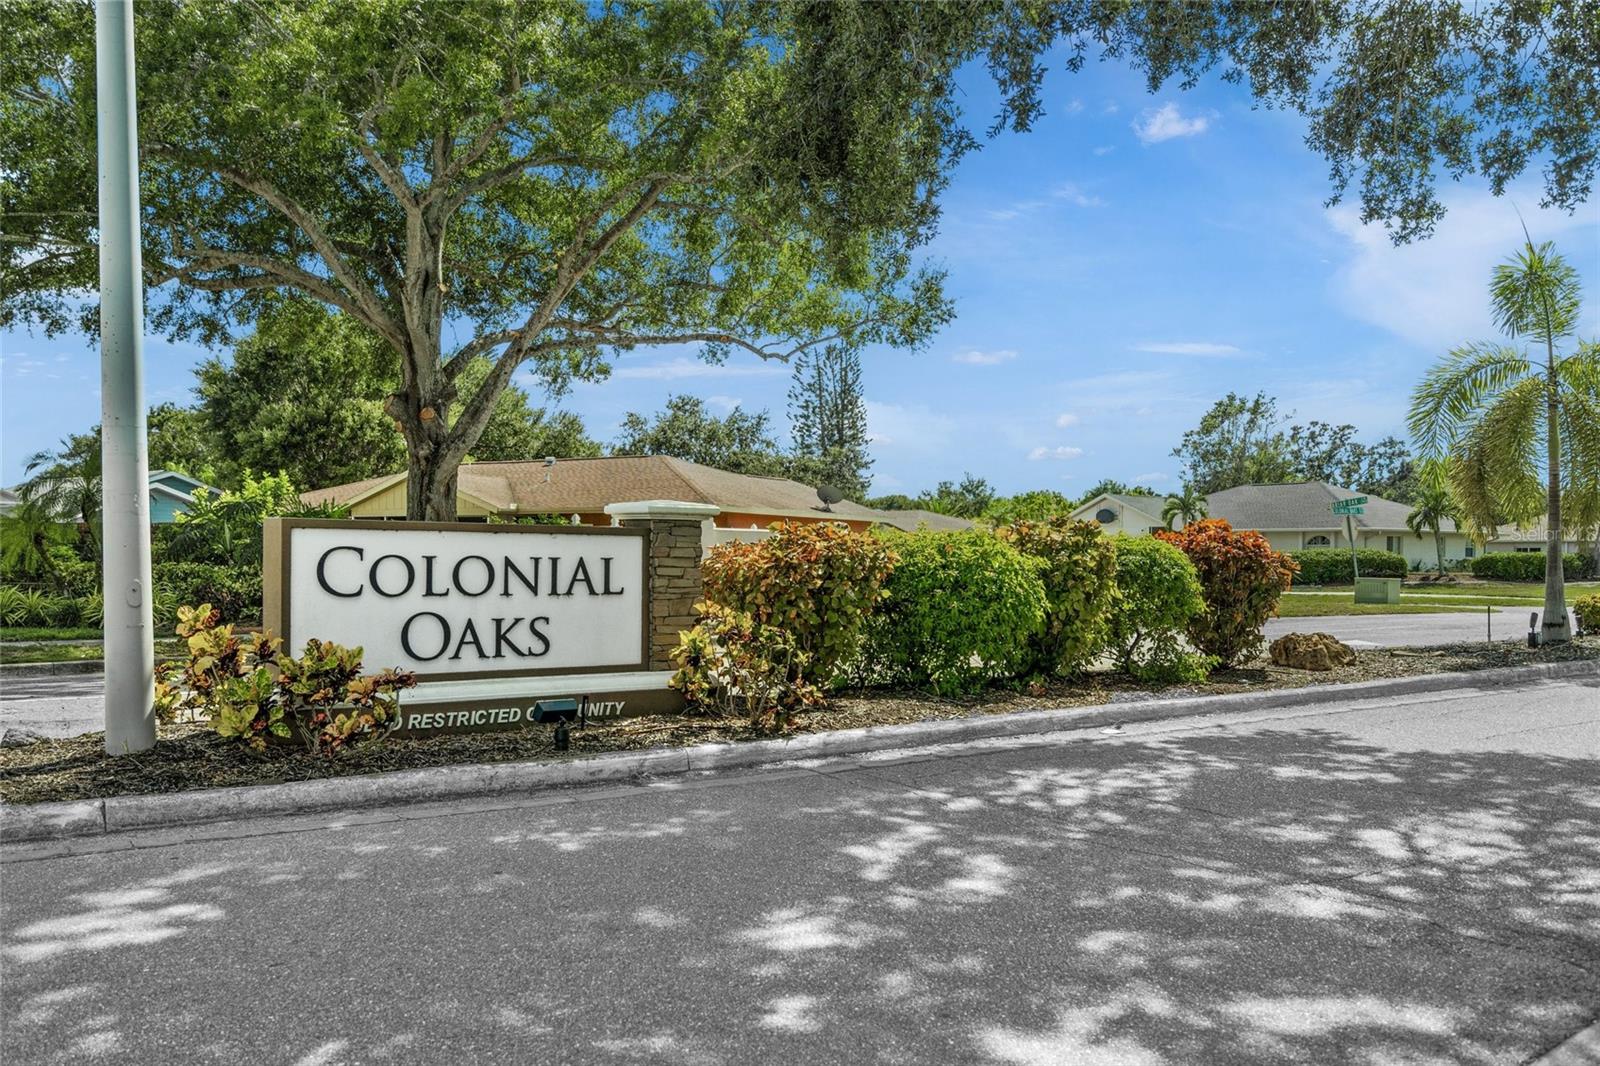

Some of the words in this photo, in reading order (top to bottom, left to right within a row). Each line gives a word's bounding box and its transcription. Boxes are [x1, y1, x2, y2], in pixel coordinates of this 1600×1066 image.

[316, 545, 625, 599] COLONIAL
[400, 611, 551, 662] OAKS
[407, 707, 522, 730] RESTRICTED
[526, 701, 625, 721] CUNITY
